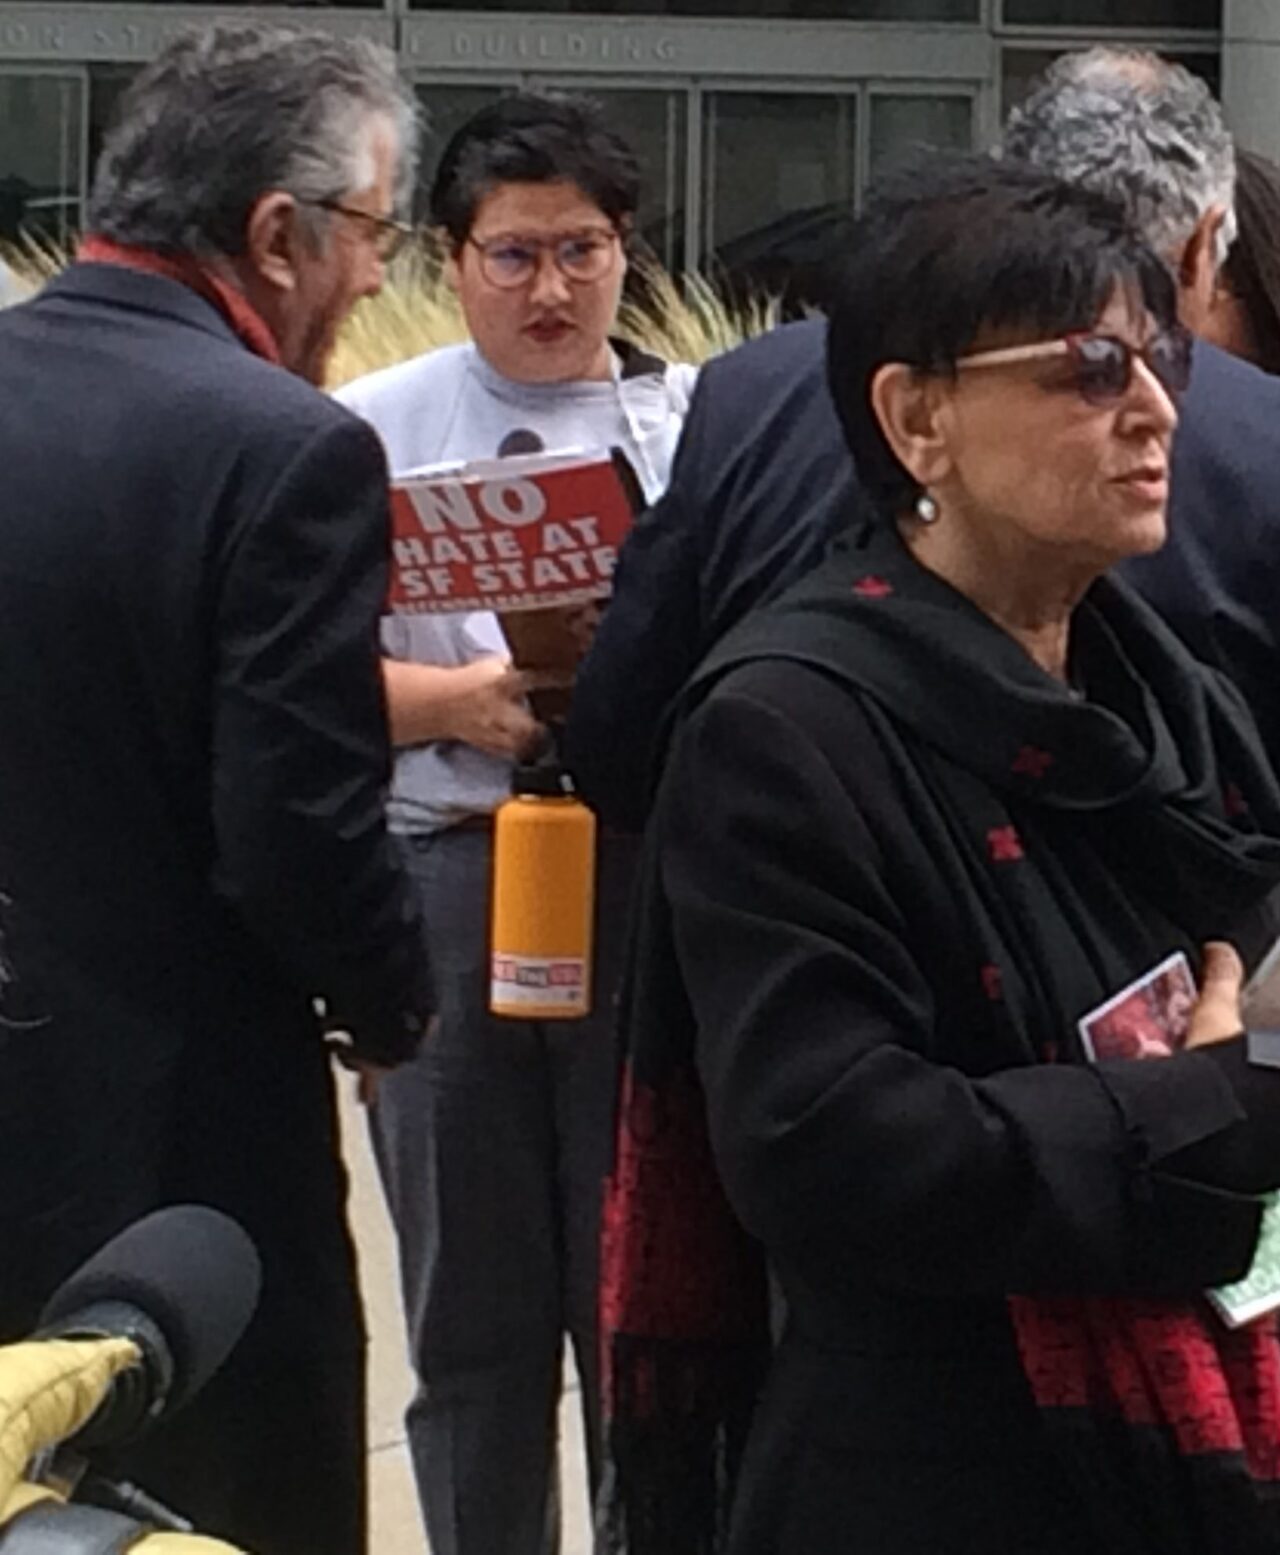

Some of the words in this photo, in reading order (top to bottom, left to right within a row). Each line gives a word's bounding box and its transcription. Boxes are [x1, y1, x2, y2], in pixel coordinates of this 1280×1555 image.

[453, 36, 682, 62] BUILDING
[406, 478, 546, 533] NO
[392, 529, 522, 567] HATE
[542, 516, 599, 552] AT
[401, 567, 454, 598] SF
[472, 545, 618, 592] STATE
